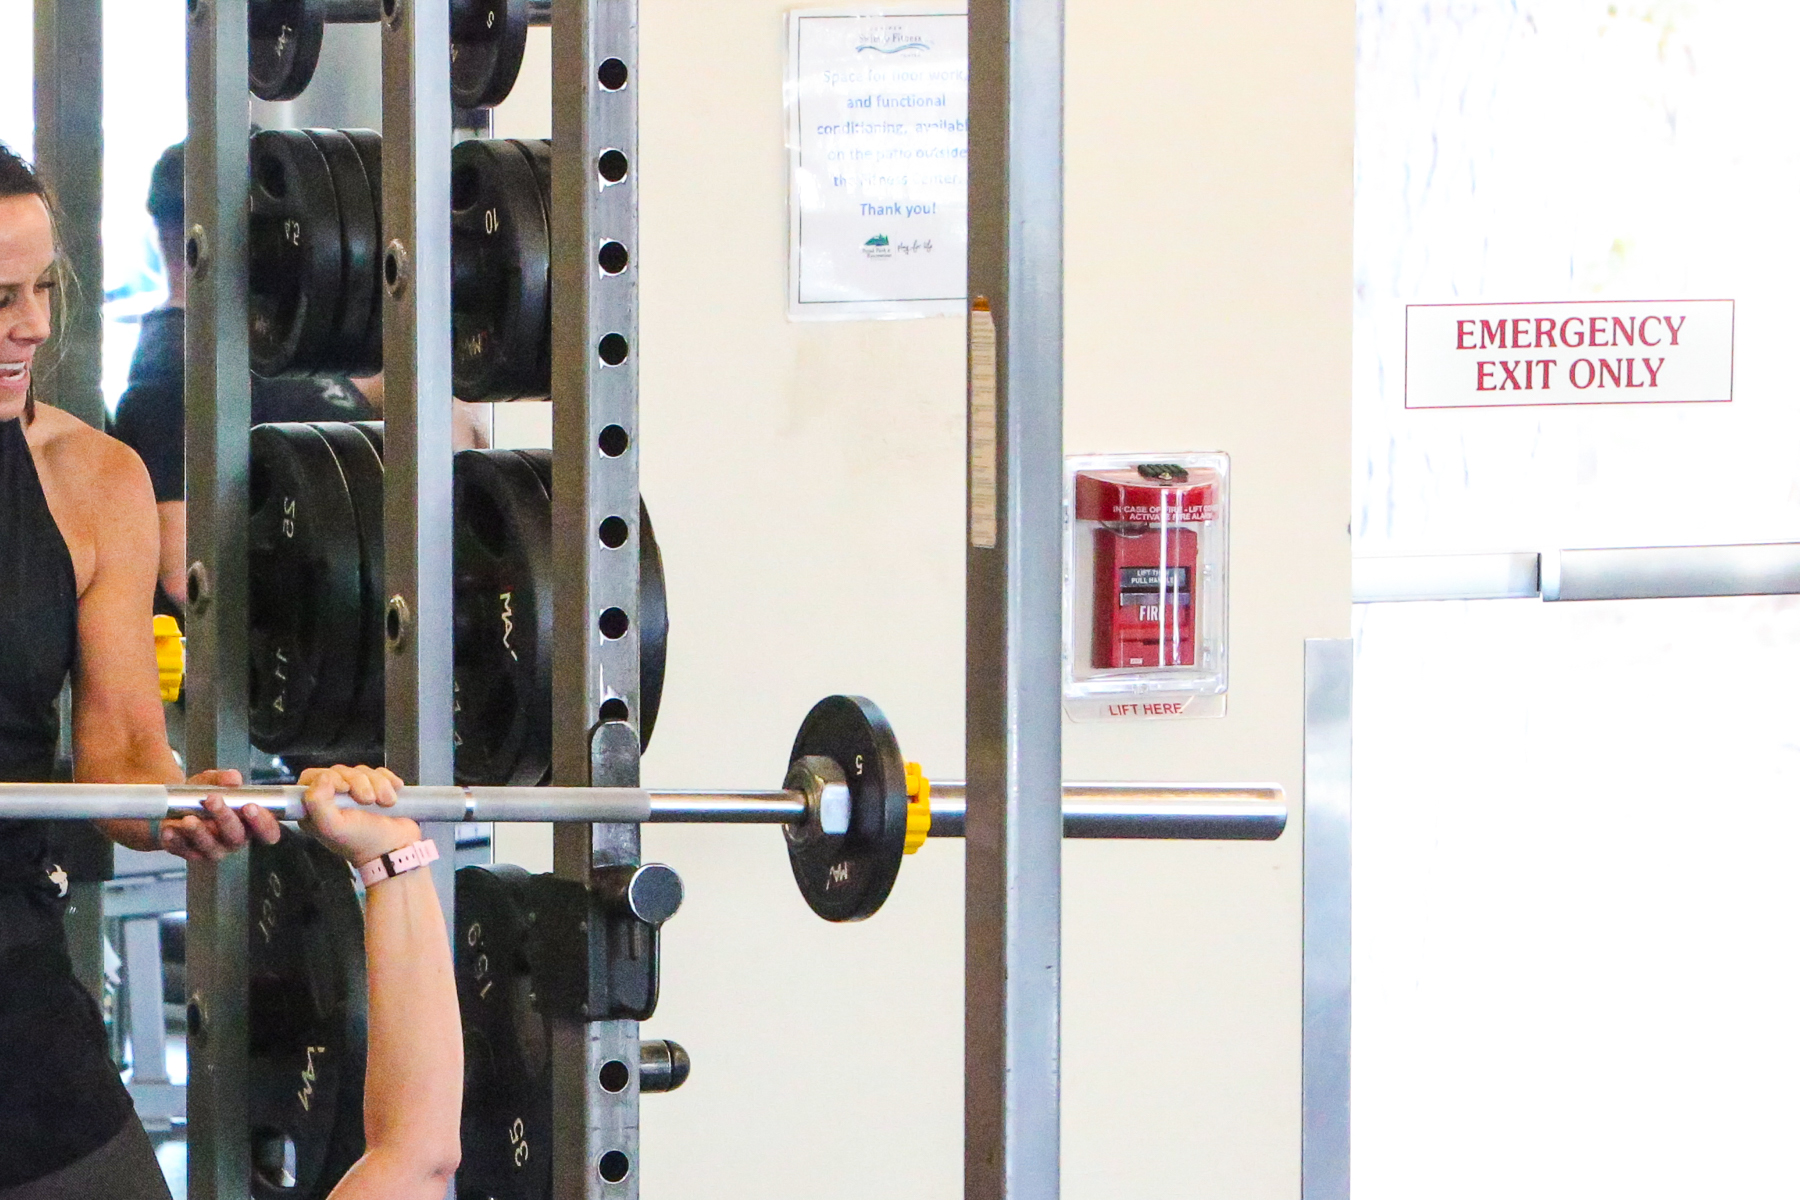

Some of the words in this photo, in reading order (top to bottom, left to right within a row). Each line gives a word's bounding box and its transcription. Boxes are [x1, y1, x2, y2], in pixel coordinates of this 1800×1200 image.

[847, 95, 872, 109] and
[876, 94, 946, 109] functional
[915, 119, 967, 134] availabl
[850, 148, 873, 161] the
[860, 202, 902, 216] Thank
[905, 202, 937, 218] you!
[1456, 316, 1686, 350] EMERGENCY
[1476, 360, 1557, 391] EXIT
[1569, 357, 1665, 389] ONLY
[1124, 505, 1147, 513] CASE
[1163, 505, 1183, 513] IRE
[1130, 512, 1170, 521] ACTIVAE
[1109, 703, 1138, 716] LIFT
[1143, 702, 1183, 715] HERE
